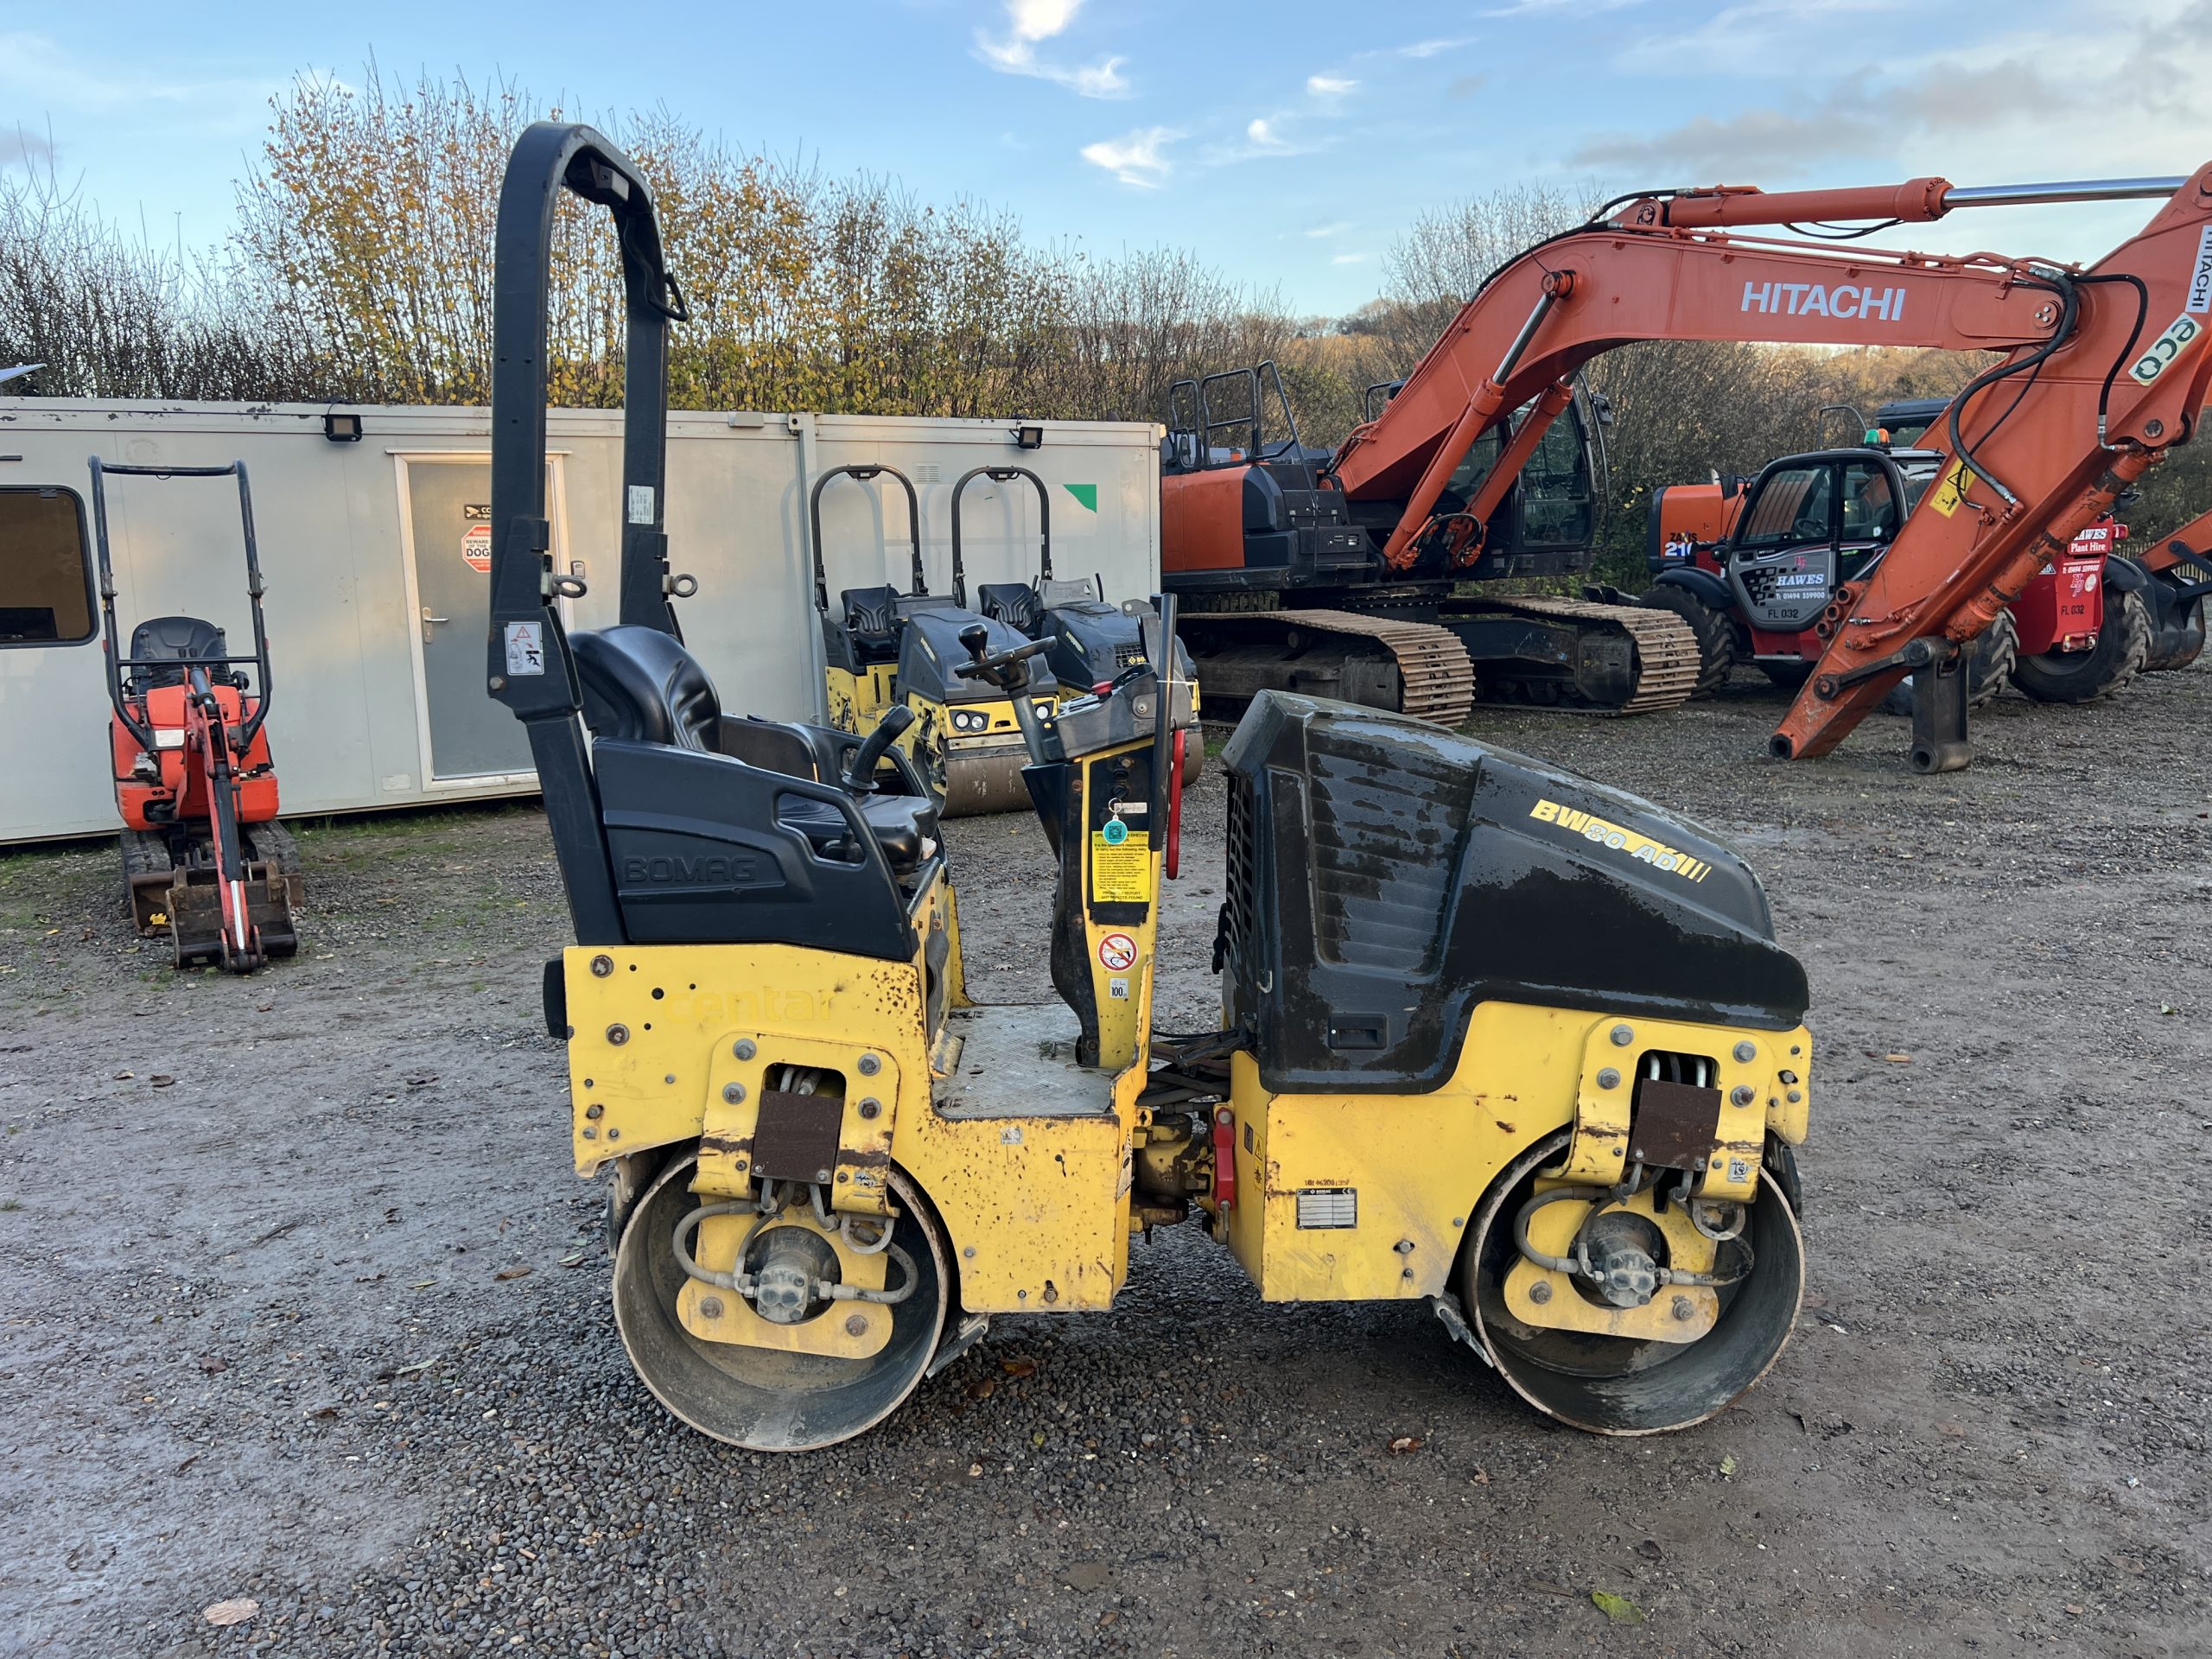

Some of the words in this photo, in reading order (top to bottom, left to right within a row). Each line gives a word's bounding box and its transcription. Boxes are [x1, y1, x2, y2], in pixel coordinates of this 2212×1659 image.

[1741, 282, 1906, 321] HITACHI
[1669, 531, 1697, 542] ZAXIS
[2074, 528, 2108, 541] AWES
[467, 548, 490, 556] DOG
[2070, 543, 2088, 552] Plant
[2089, 542, 2106, 551] Hire
[1776, 574, 1824, 586] HAWES
[1768, 609, 1778, 618] FL
[1781, 608, 1799, 618] 032
[2061, 606, 2069, 615] FL
[2071, 605, 2084, 614] 032
[624, 856, 758, 882] BOMAG
[1111, 986, 1123, 996] 100
